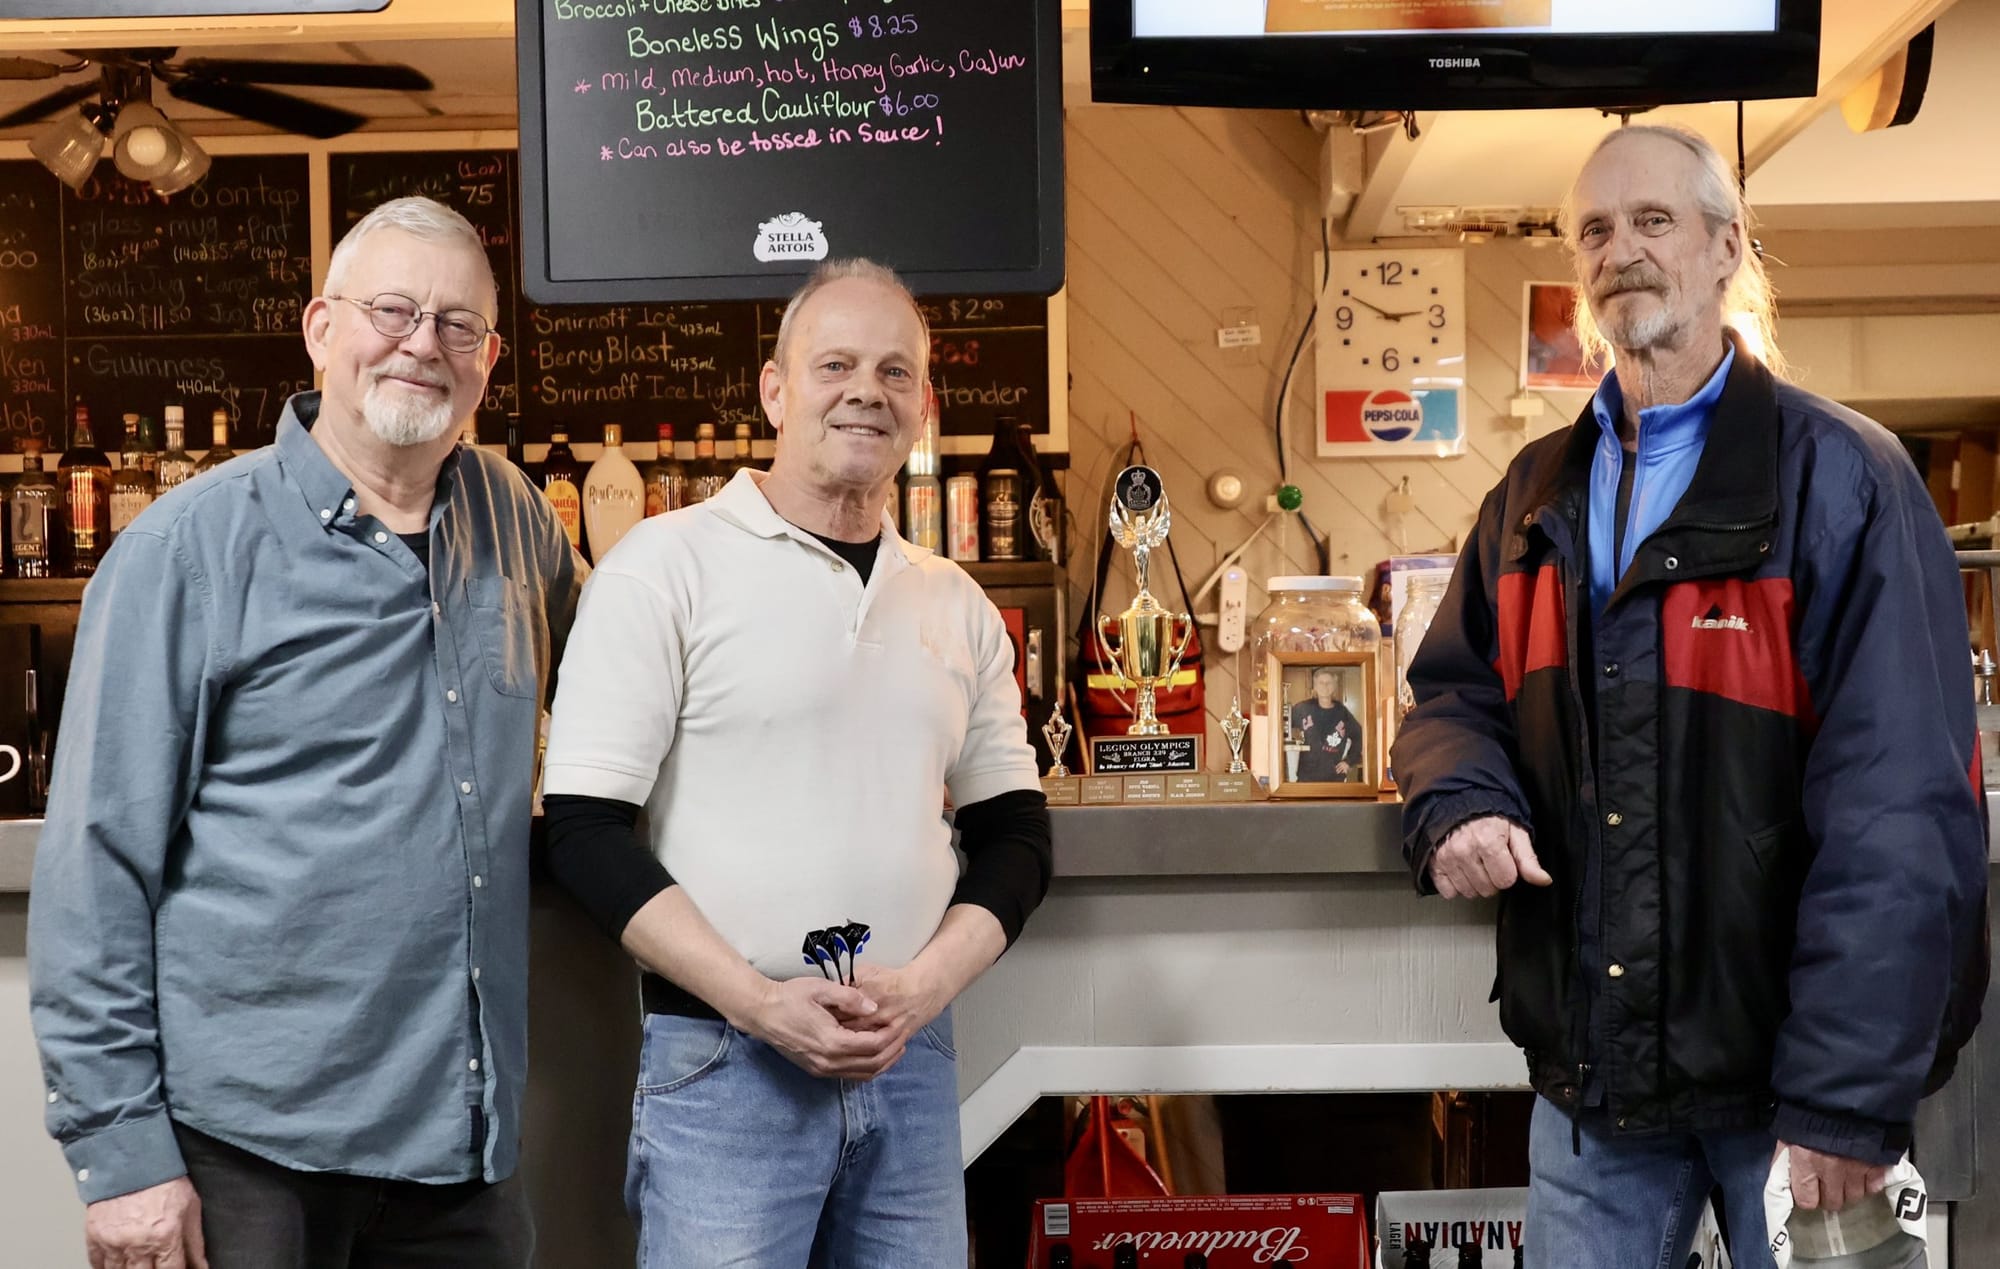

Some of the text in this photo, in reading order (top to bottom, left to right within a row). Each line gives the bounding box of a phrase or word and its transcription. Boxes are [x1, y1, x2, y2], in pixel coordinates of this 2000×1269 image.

[626, 25, 743, 58] Boneless
[755, 17, 840, 62] Wings
[822, 58, 886, 93] Honey
[1428, 58, 1481, 68] TOSHIBA
[636, 88, 940, 132] Battered Cauliflour $6.00
[618, 137, 658, 159] Can
[666, 139, 712, 156] also
[717, 137, 746, 156] be
[748, 129, 823, 150] tossed
[828, 127, 852, 144] in
[216, 186, 249, 207] on
[257, 173, 300, 216] tap
[767, 232, 814, 242] STELLA
[767, 243, 815, 253] ARTOIS
[1376, 261, 1403, 285] 12
[535, 306, 631, 335] Smirnoff
[637, 306, 680, 328] Ice
[1335, 306, 1354, 330] 9
[1428, 304, 1446, 328] 3
[87, 344, 226, 379] Guinness
[538, 342, 602, 375] Berry
[606, 330, 675, 364] Blast
[1381, 347, 1400, 372] 6
[540, 366, 751, 411] Smirnoff Ice Light
[1099, 741, 1191, 752] LEGION OLYMPICS
[1404, 1221, 1523, 1250] ANADIAN
